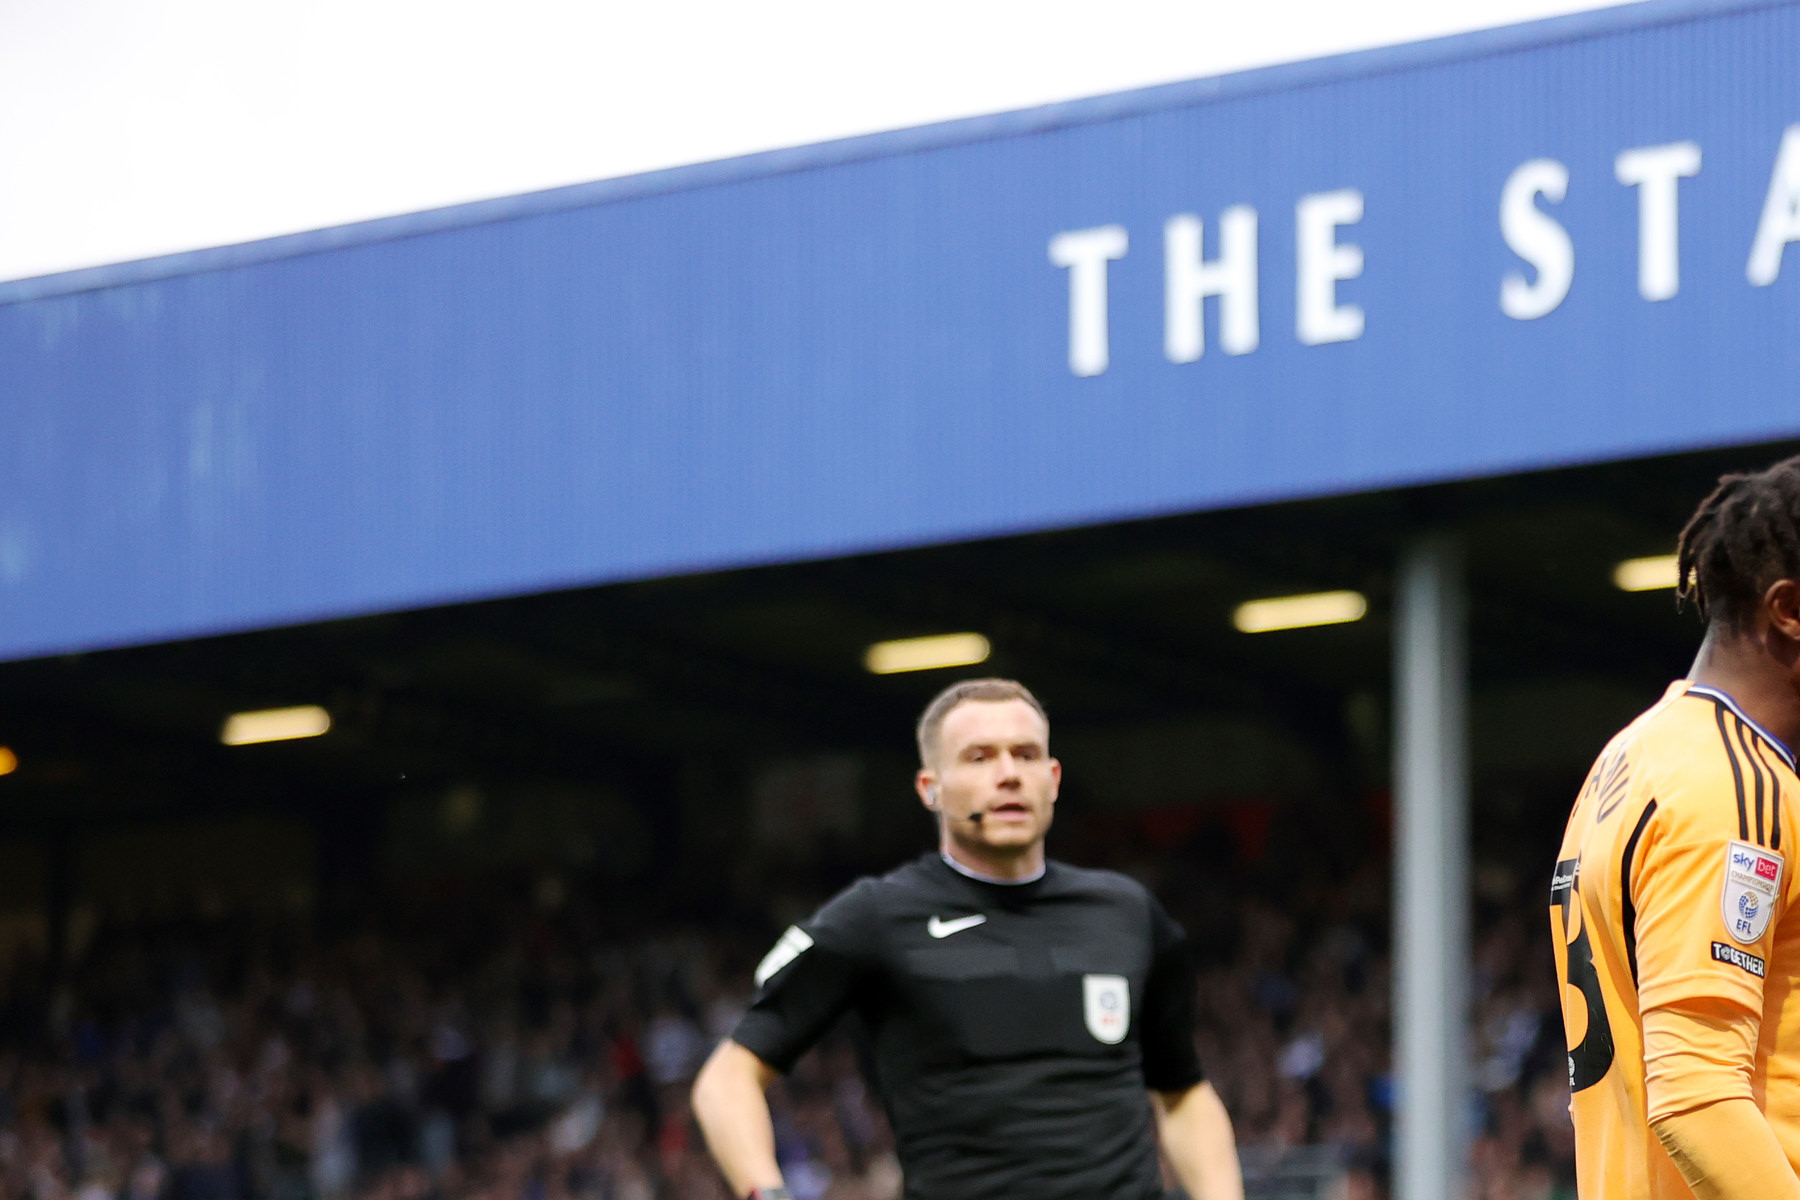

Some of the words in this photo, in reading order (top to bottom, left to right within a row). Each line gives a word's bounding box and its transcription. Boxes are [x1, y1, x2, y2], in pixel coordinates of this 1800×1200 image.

[1048, 187, 1366, 378] THE
[1733, 852, 1755, 871] sky
[1757, 859, 1776, 877] bet
[1736, 918, 1752, 934] EFL
